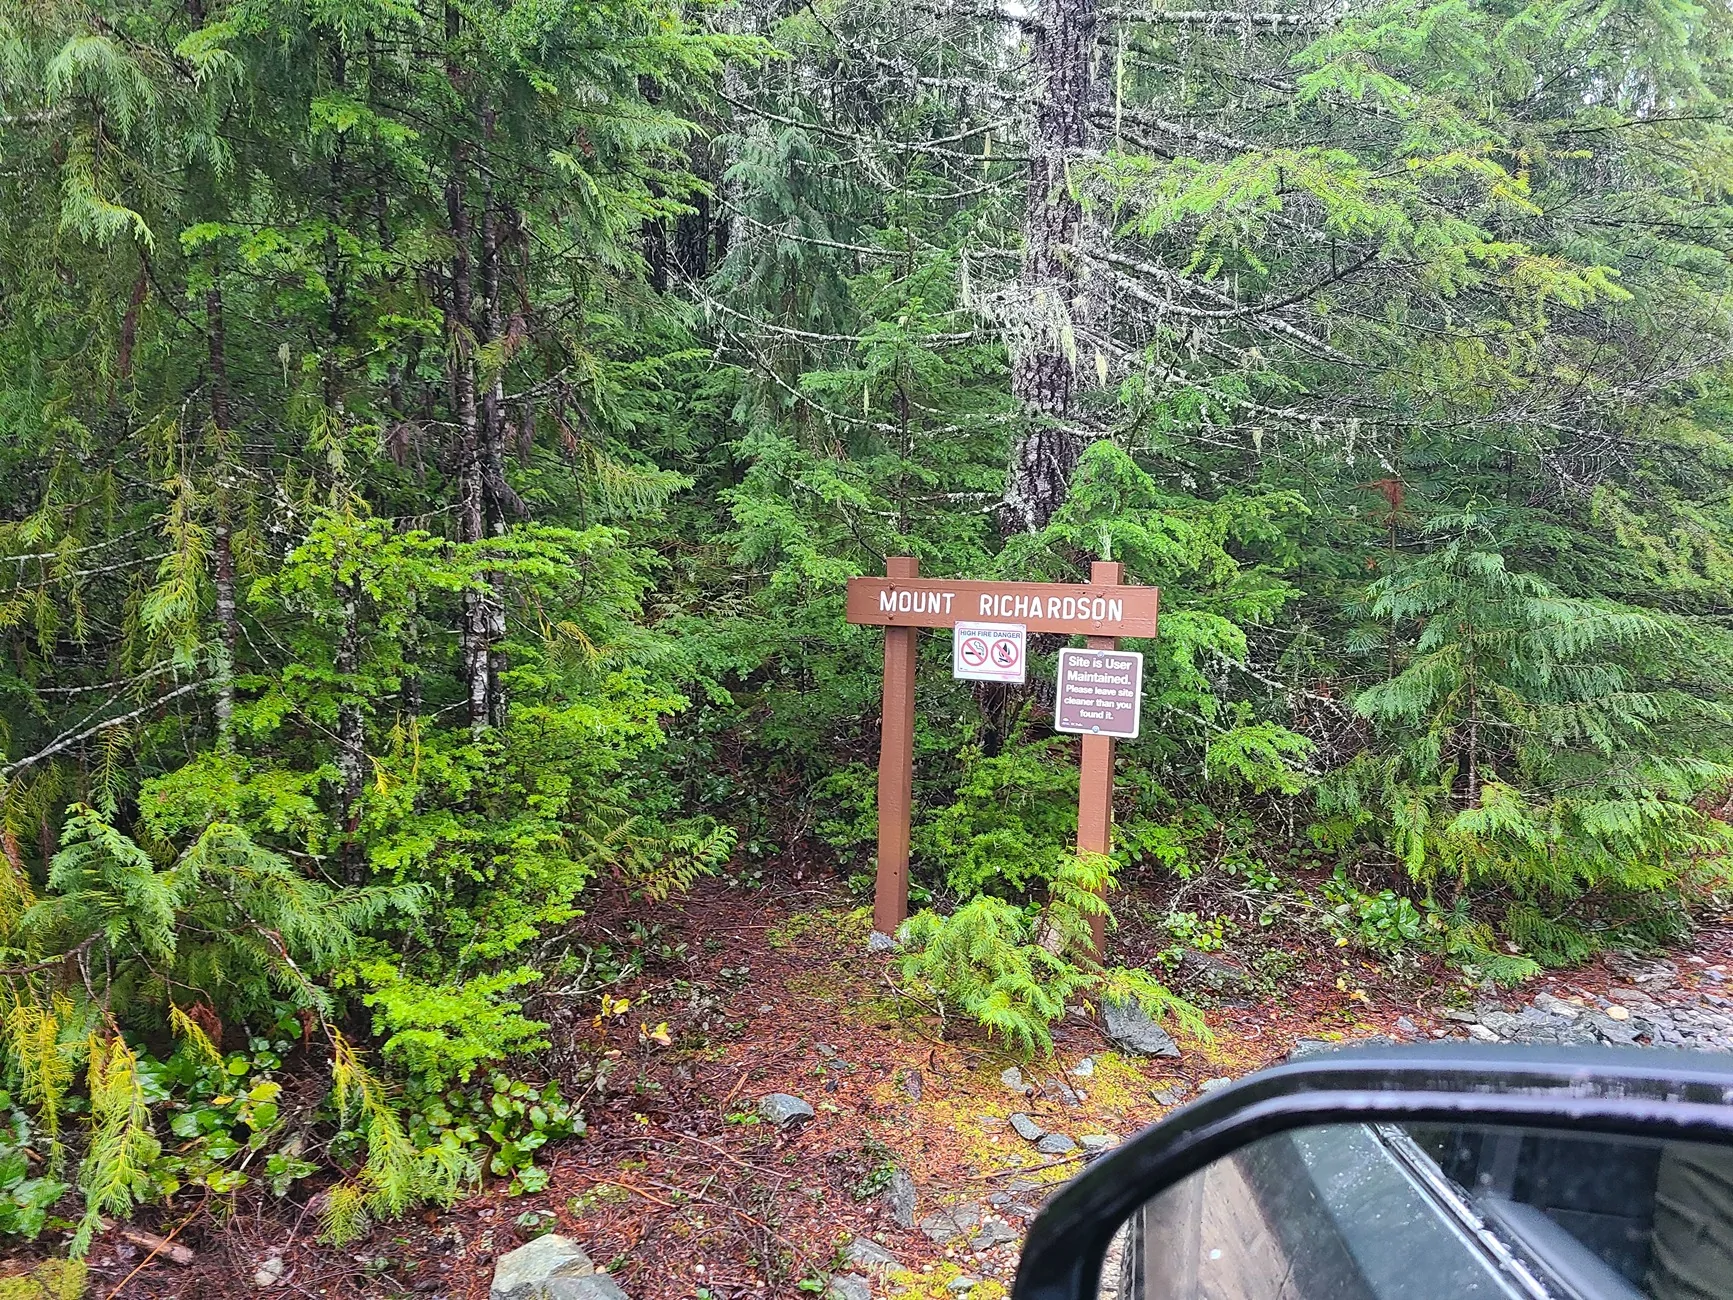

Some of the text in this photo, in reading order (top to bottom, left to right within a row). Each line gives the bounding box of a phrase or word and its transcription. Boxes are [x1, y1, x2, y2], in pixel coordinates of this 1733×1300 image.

[879, 590, 1123, 622] MOUNT RICHARDSON
[1068, 656, 1132, 670] Site is User
[1067, 670, 1131, 685] Maintained.
[1066, 684, 1134, 697] Please leave site
[1064, 696, 1132, 710] cleaner than you
[1079, 709, 1114, 720] found it.
